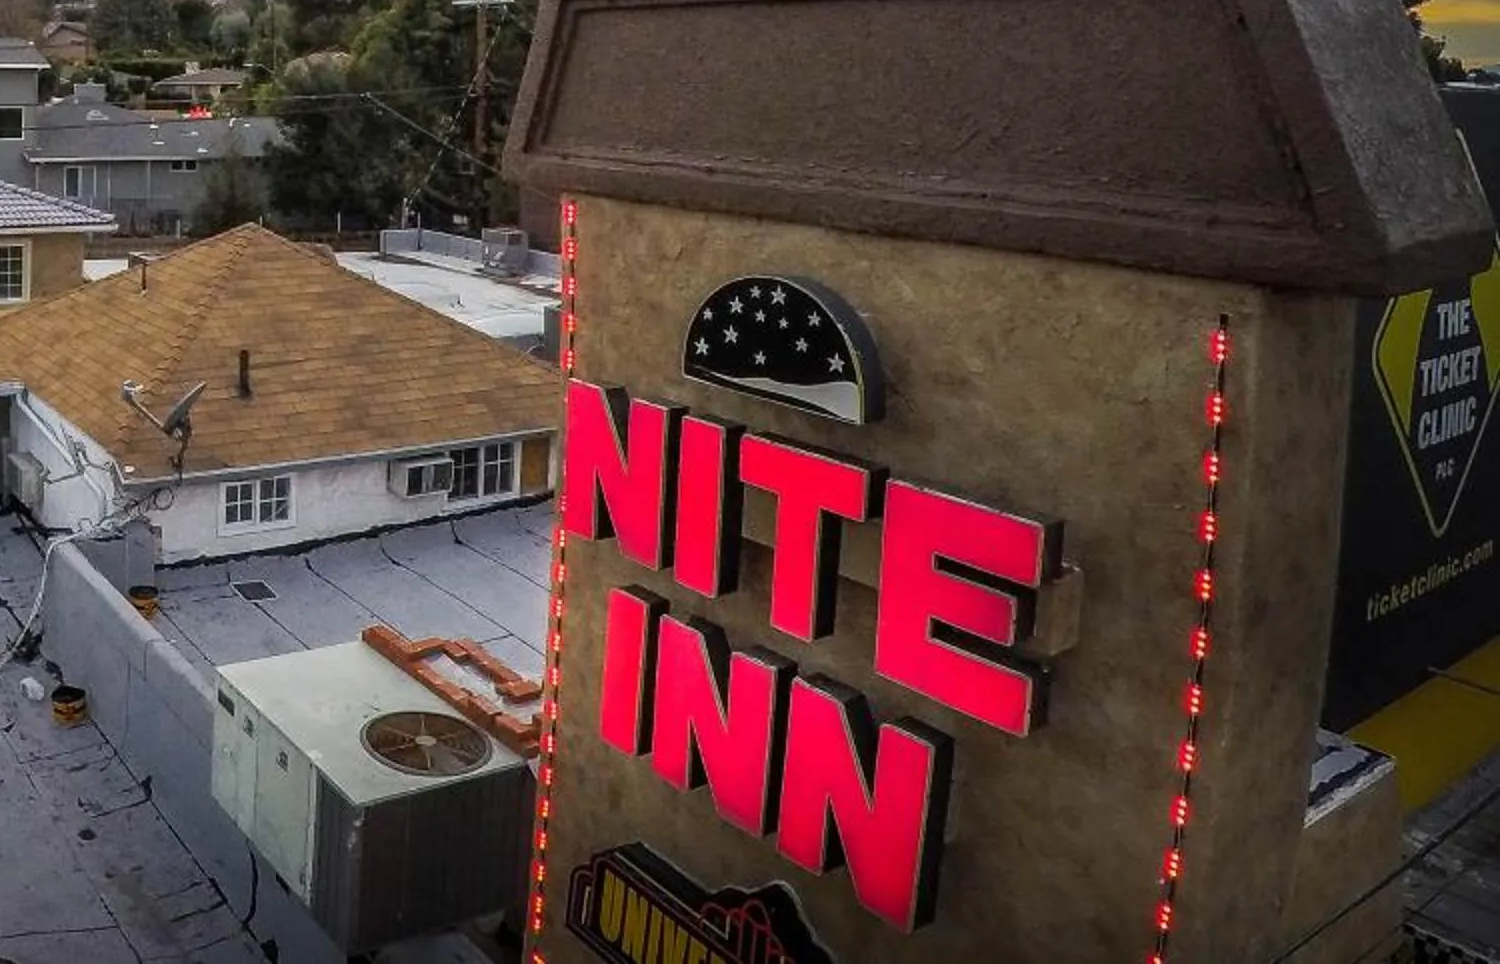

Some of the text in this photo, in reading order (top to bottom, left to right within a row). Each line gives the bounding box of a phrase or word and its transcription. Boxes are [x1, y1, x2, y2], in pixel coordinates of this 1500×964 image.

[1437, 297, 1472, 340] THE
[1419, 345, 1482, 397] TICKET
[1417, 396, 1477, 450] CLINIC
[562, 377, 1045, 737] NITE
[1366, 539, 1493, 621] ticketclinic.com
[600, 588, 937, 935] INN
[600, 868, 726, 964] UNIV
